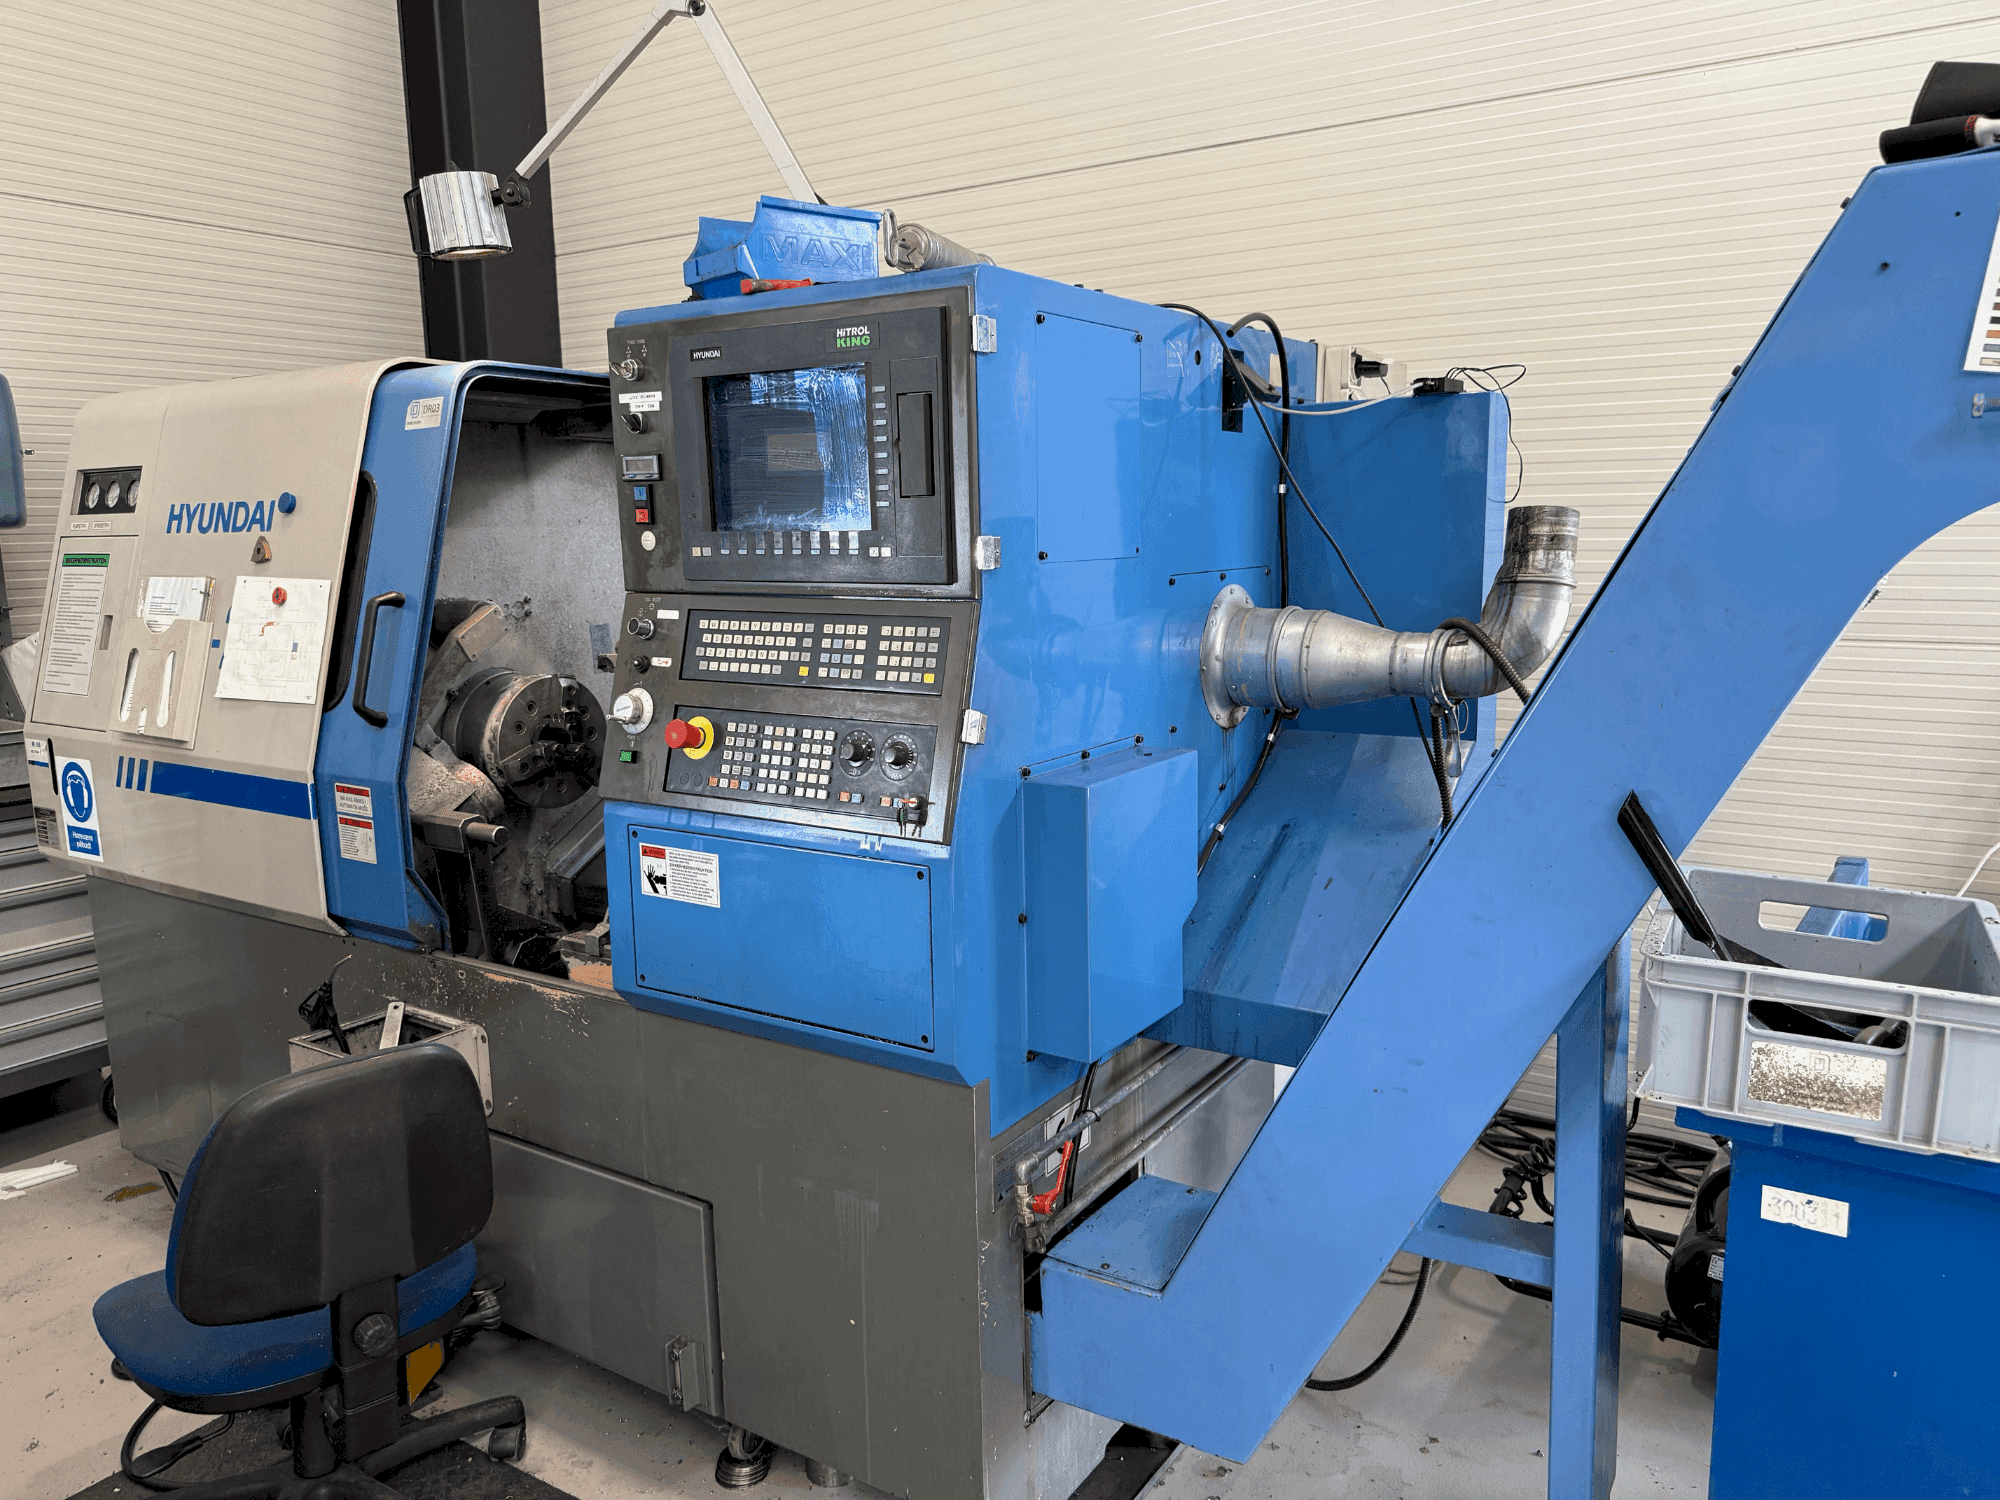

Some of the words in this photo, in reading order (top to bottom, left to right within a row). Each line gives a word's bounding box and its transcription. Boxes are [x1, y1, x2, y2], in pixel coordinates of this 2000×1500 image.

[762, 234, 871, 272] MAXI
[836, 325, 870, 338] HiTROL
[836, 335, 871, 348] KING
[693, 350, 721, 360] HYUNDAI
[166, 500, 276, 534] HYUNDAI
